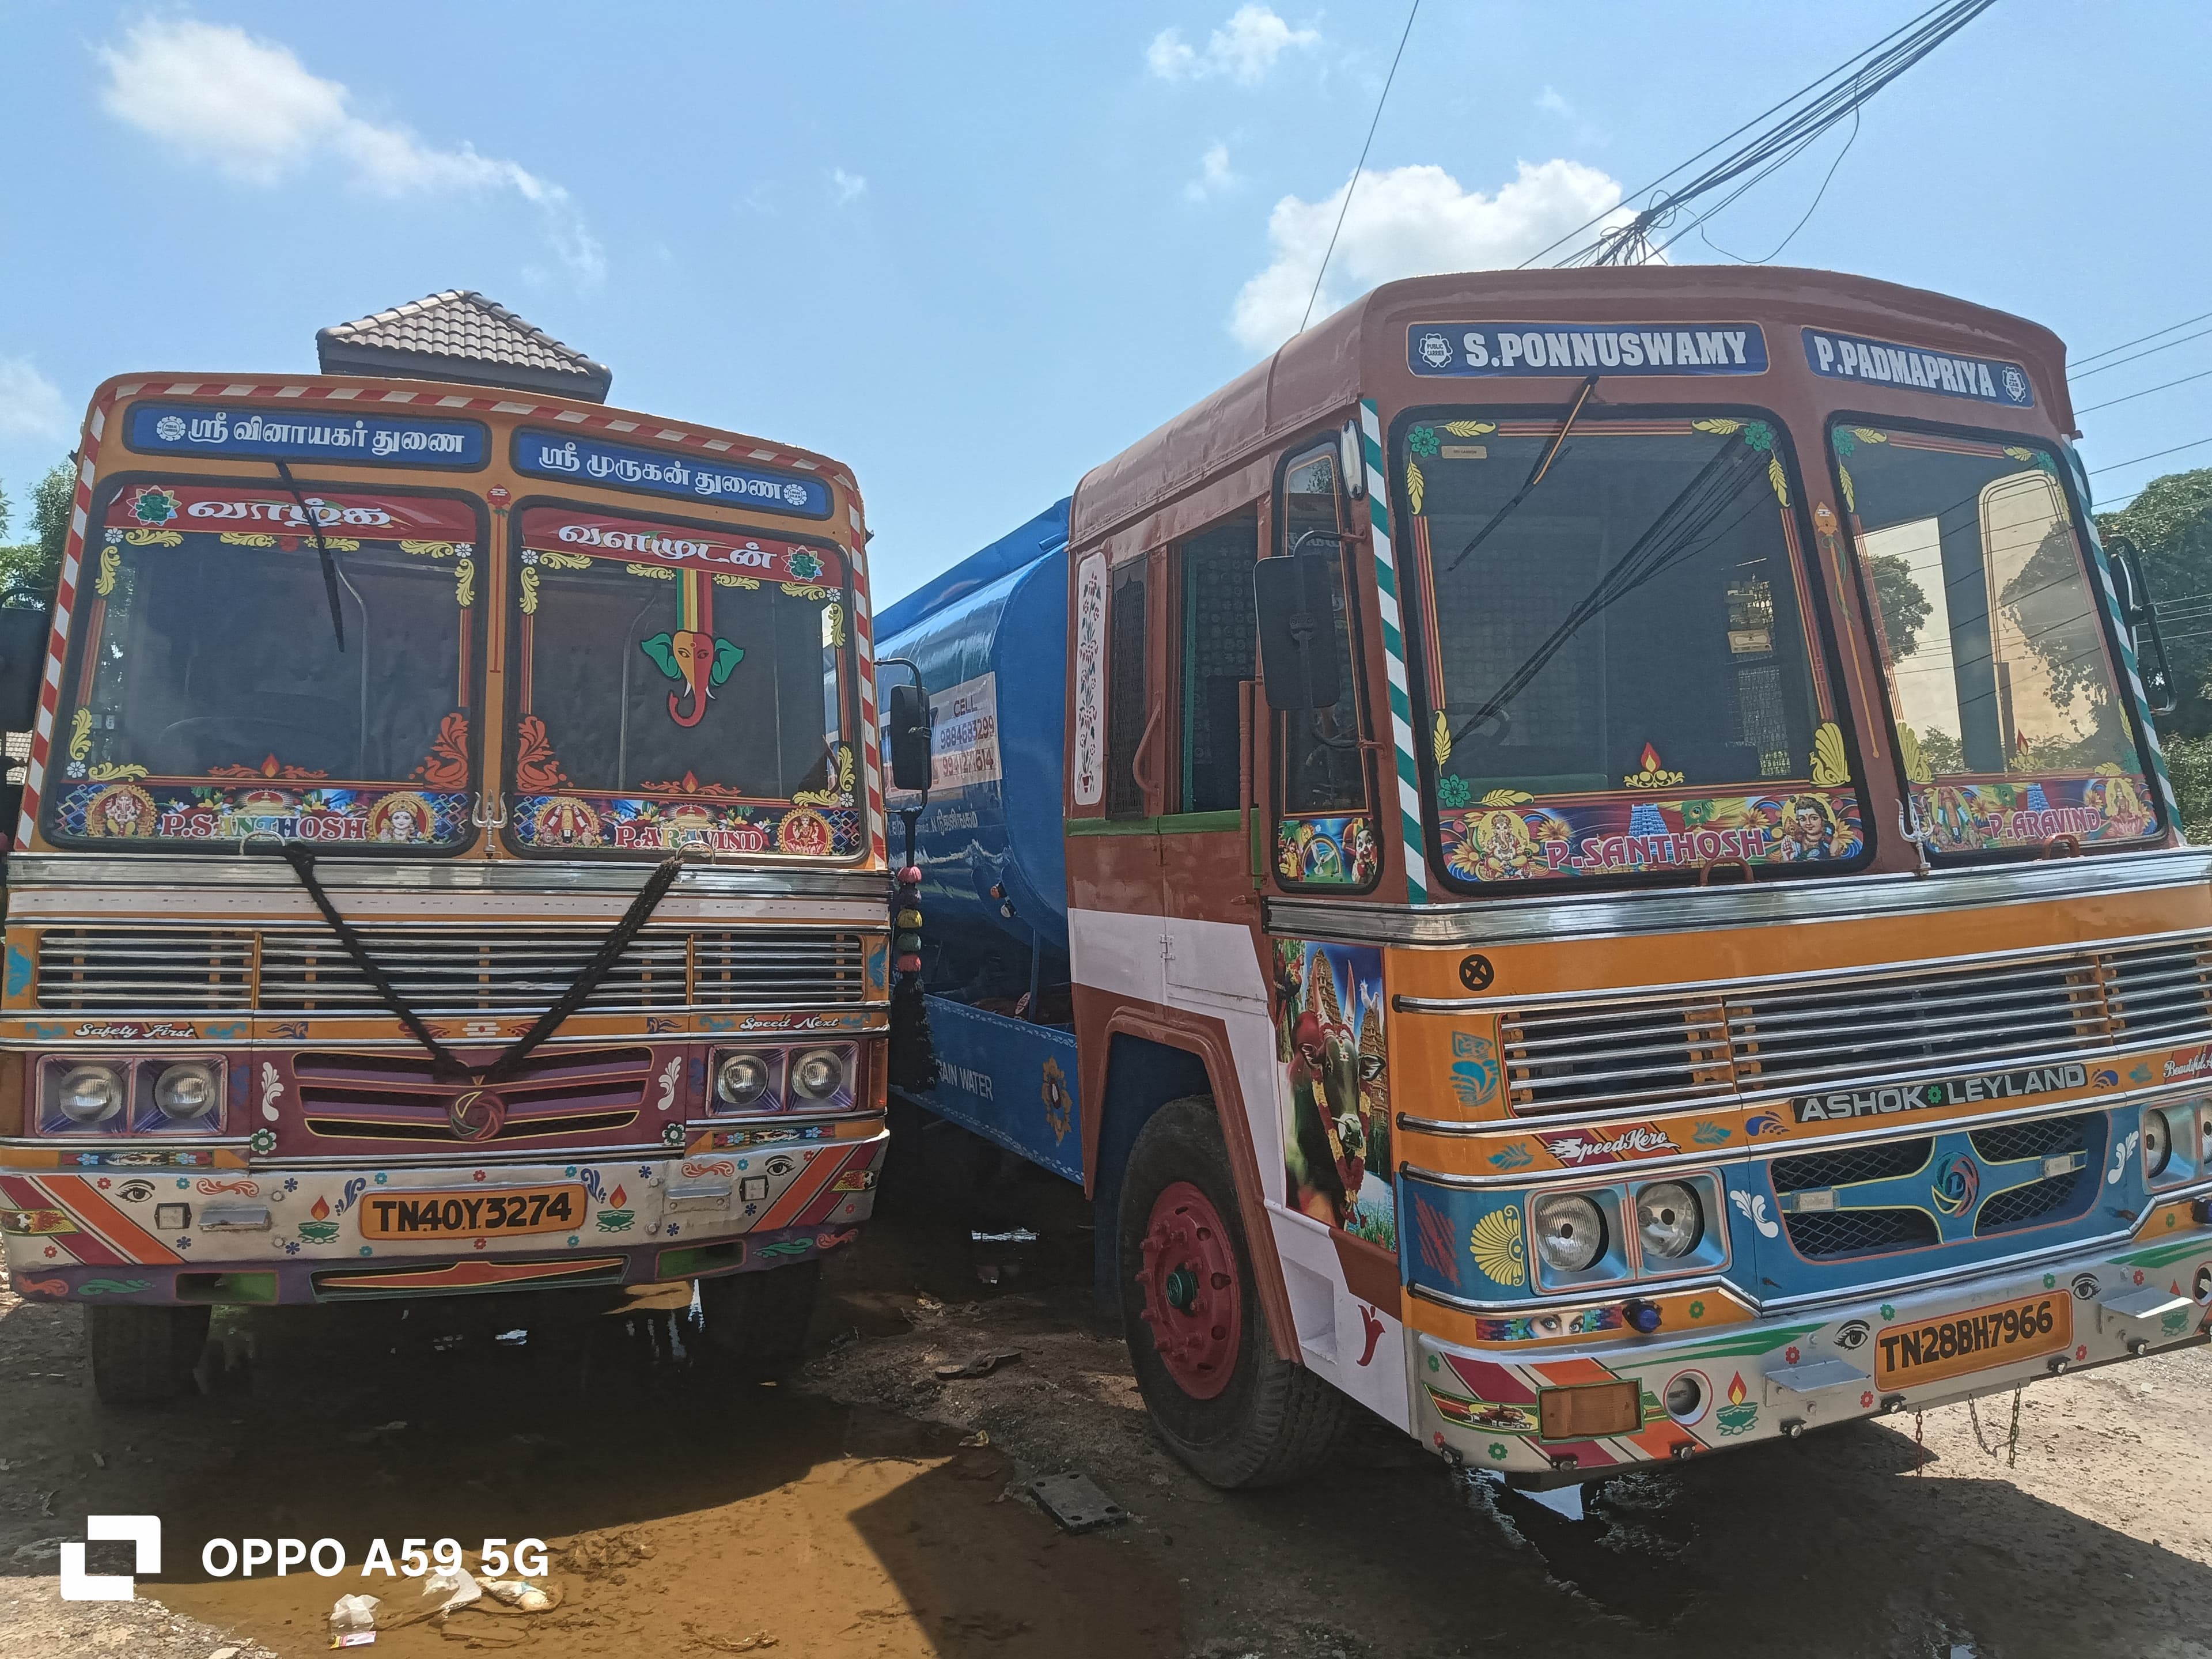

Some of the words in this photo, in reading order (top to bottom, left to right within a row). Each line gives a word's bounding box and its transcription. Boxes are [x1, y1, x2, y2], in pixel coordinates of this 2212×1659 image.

[1464, 331, 1747, 368] S.PONNUSWAMY
[1813, 336, 1997, 397] P.PADMAPRIYA
[372, 430, 464, 456] துணை
[587, 454, 691, 486] முருகன்
[695, 472, 782, 500] துணை
[188, 497, 391, 528] வாழ்க
[558, 524, 778, 569] வளமுடன்
[953, 695, 978, 718] CELL
[160, 813, 369, 842] P.SANTHOSH
[1987, 806, 2102, 840] P.ARAVIND
[613, 826, 764, 853] P.ARAVIND
[1546, 828, 1766, 870] P.SANTHOSH
[75, 1023, 138, 1037] Safety
[142, 1023, 194, 1037] First
[740, 1017, 791, 1030] Speed
[793, 1017, 839, 1028] Next
[2163, 1054, 2207, 1078] Beautiful
[959, 1067, 994, 1102] WATER
[1801, 1085, 1930, 1122] ASHOK
[1947, 1065, 2086, 1104] LEYLAND
